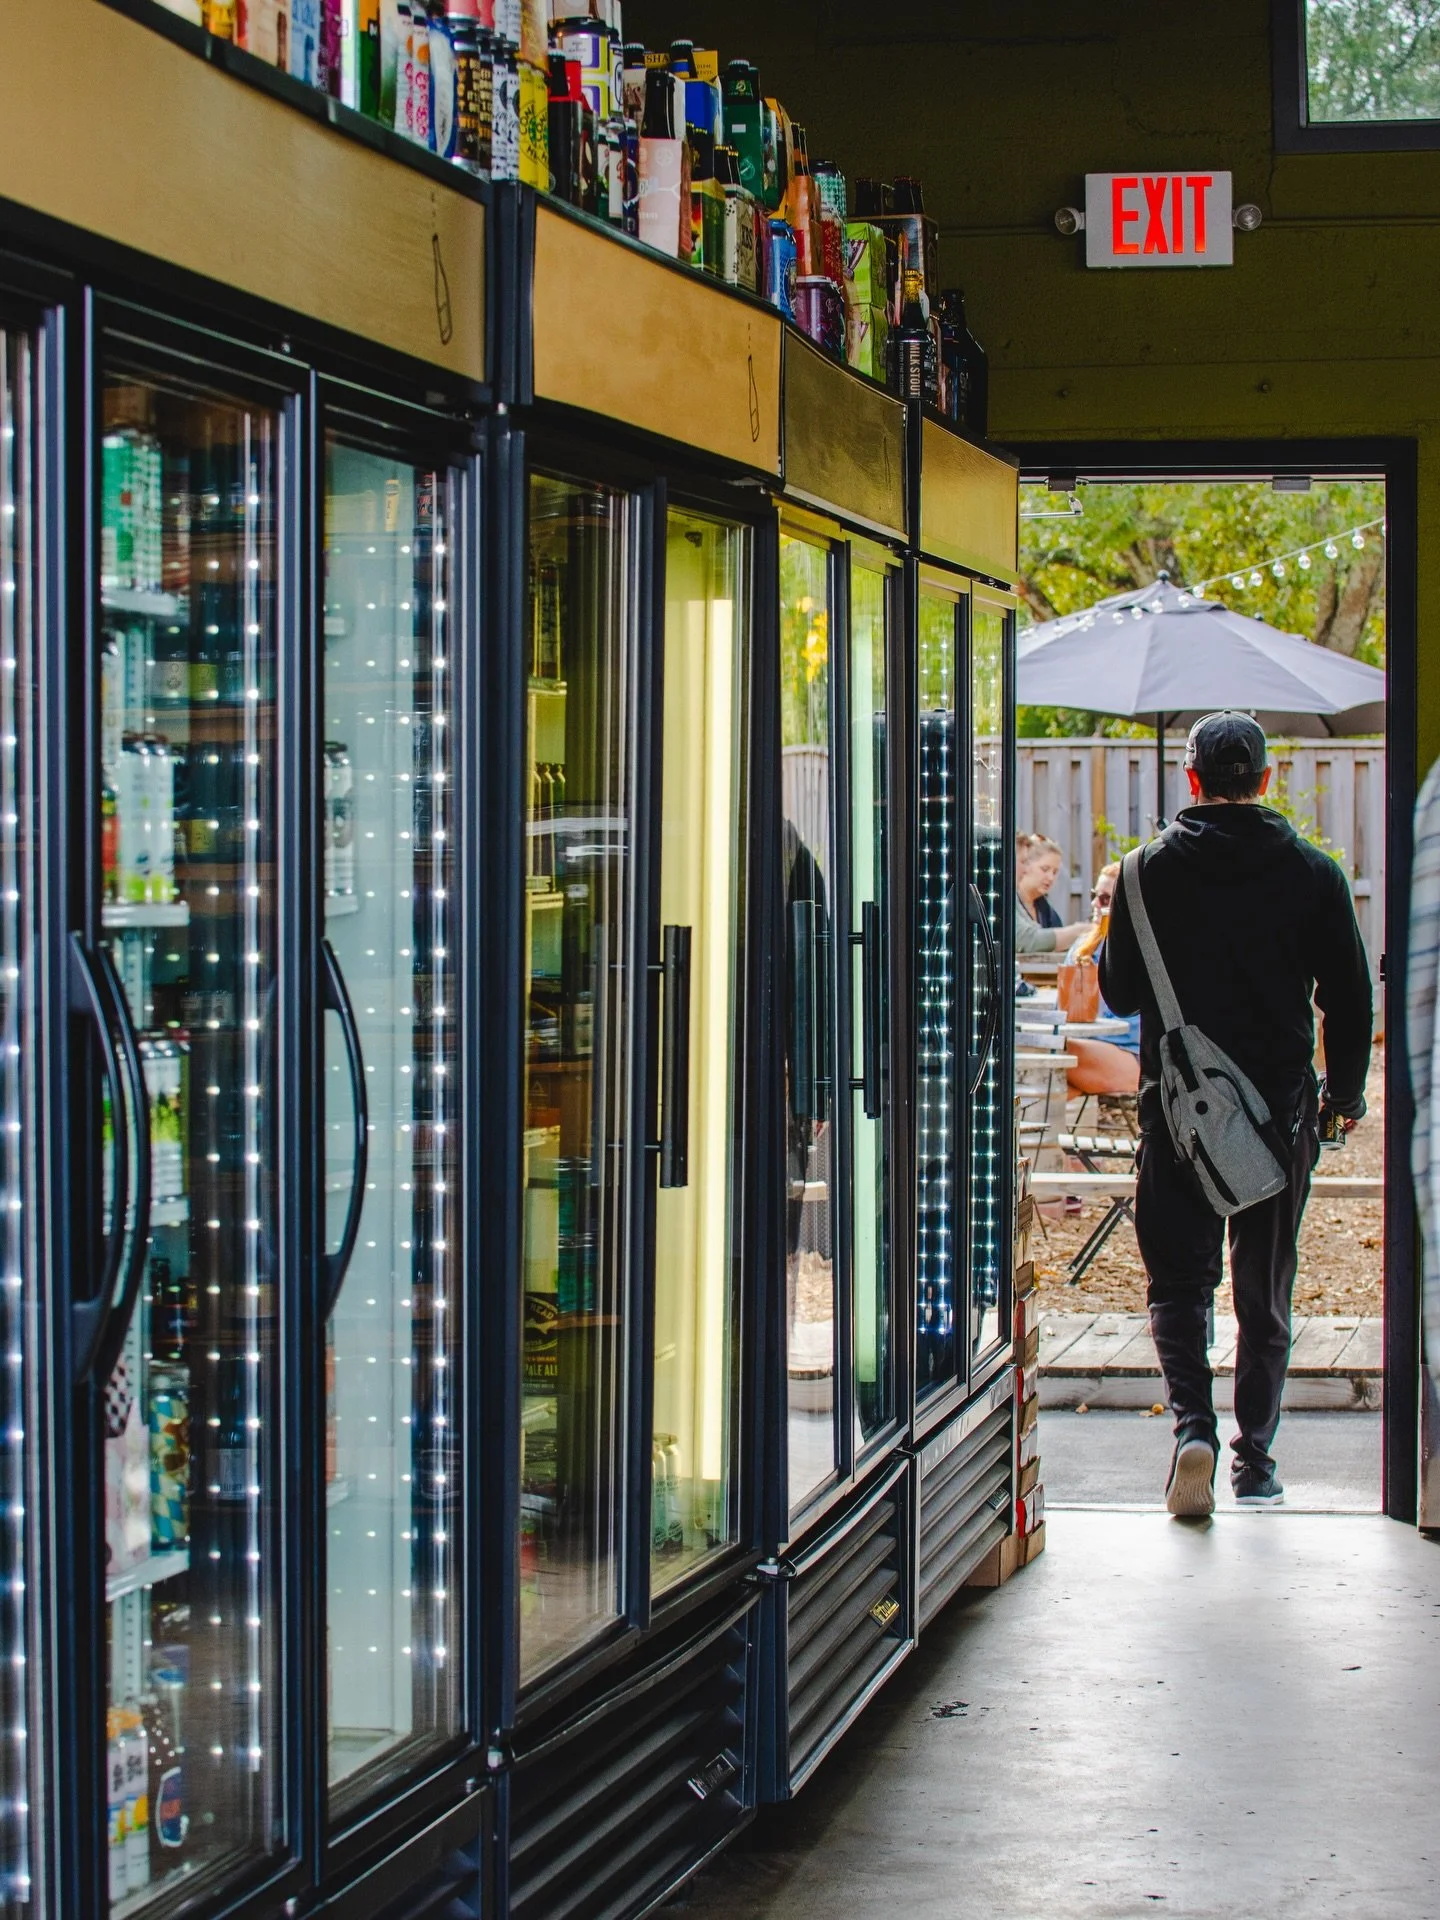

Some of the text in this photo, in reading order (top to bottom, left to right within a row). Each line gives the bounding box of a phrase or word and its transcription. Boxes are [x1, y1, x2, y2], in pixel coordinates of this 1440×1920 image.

[1112, 176, 1212, 254] EXIT
[910, 343, 921, 396] MILK STOUT
[529, 1302, 555, 1320] HEAD
